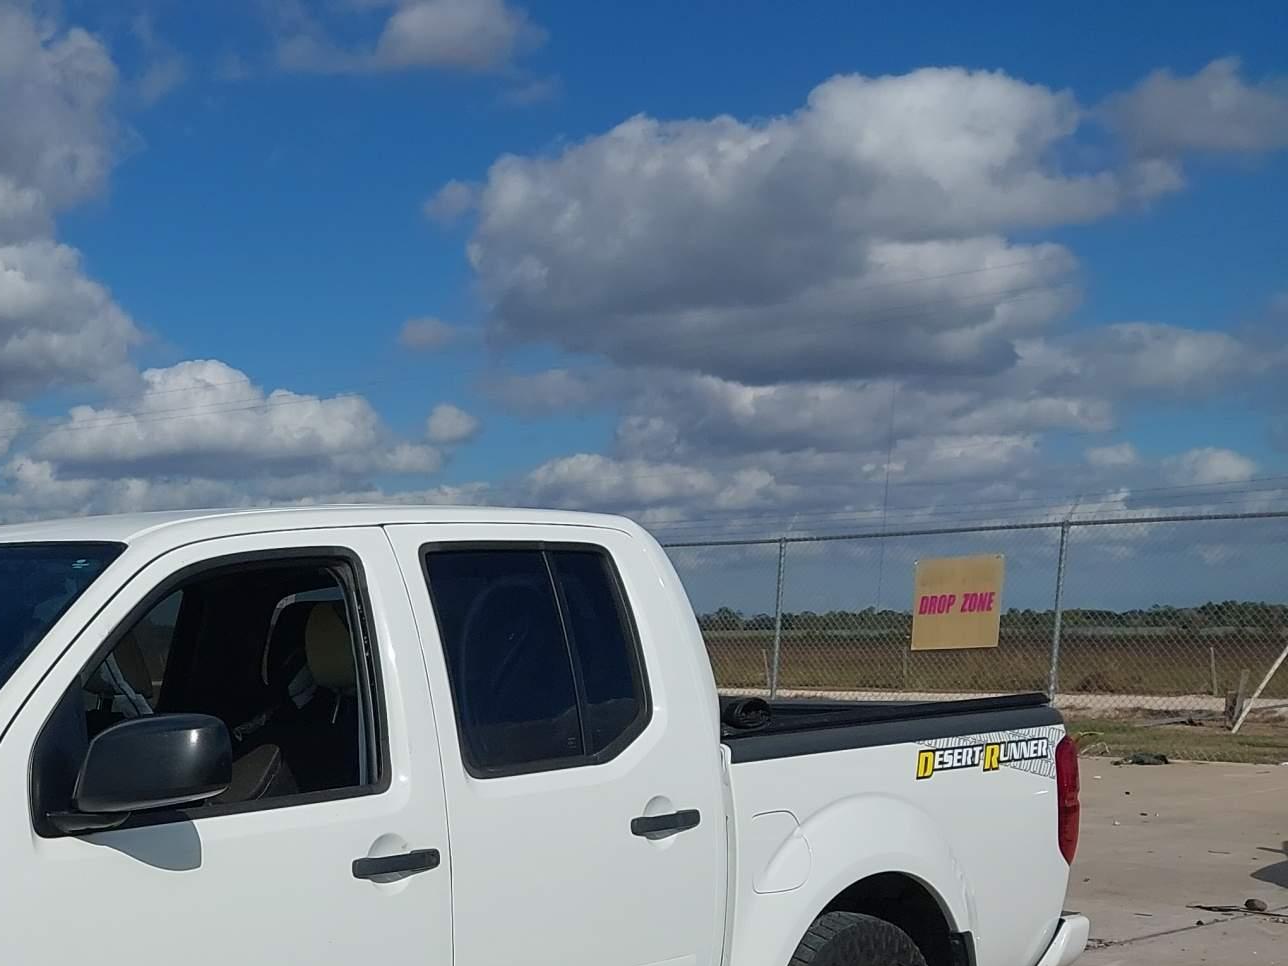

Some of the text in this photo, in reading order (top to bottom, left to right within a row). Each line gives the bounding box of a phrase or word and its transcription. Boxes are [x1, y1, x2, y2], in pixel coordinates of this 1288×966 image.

[918, 591, 996, 615] DROP ZONE
[916, 738, 1049, 780] DESERT RUNNER
